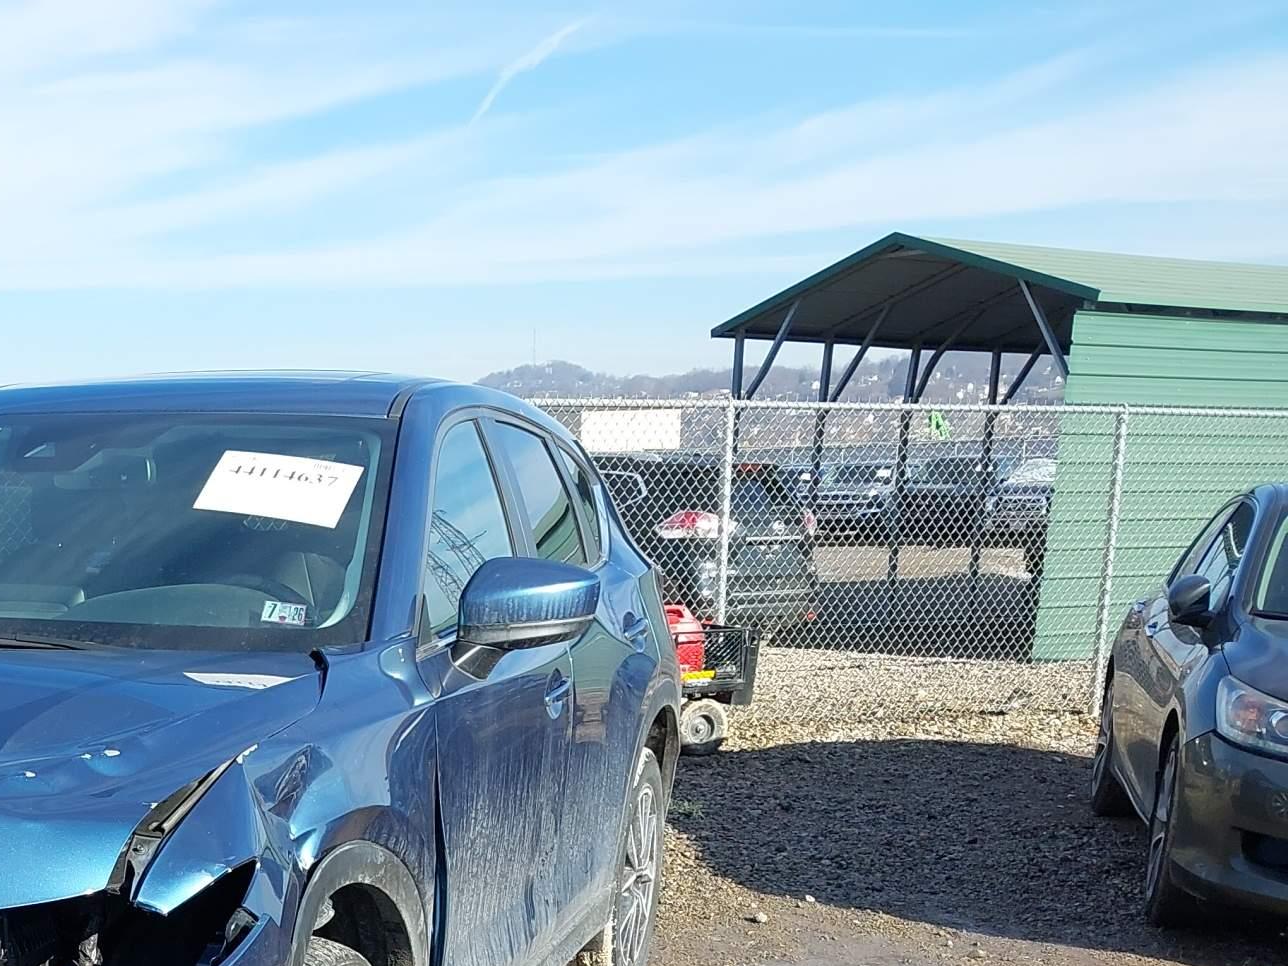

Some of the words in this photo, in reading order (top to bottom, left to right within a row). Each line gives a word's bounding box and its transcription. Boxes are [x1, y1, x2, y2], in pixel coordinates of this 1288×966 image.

[229, 465, 339, 487] 44114637
[268, 603, 278, 618] 7
[291, 606, 304, 621] 26
